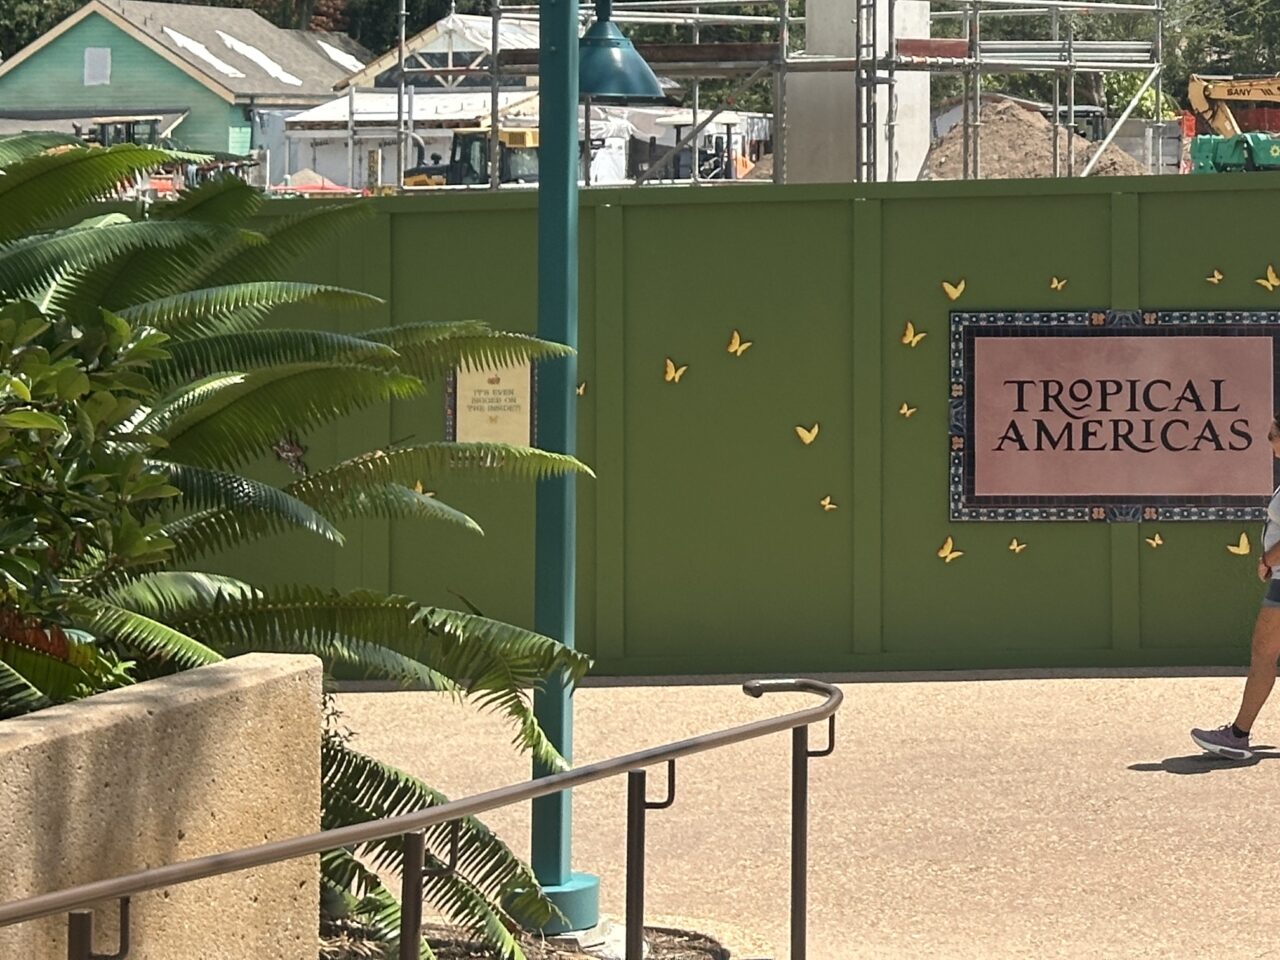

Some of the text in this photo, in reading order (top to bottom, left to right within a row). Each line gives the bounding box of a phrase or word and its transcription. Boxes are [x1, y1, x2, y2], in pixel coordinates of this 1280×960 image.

[1226, 88, 1252, 96] SANY
[466, 404, 485, 412] THE
[1003, 377, 1240, 420] TROPICAL
[991, 418, 1253, 453] AMERICAS
